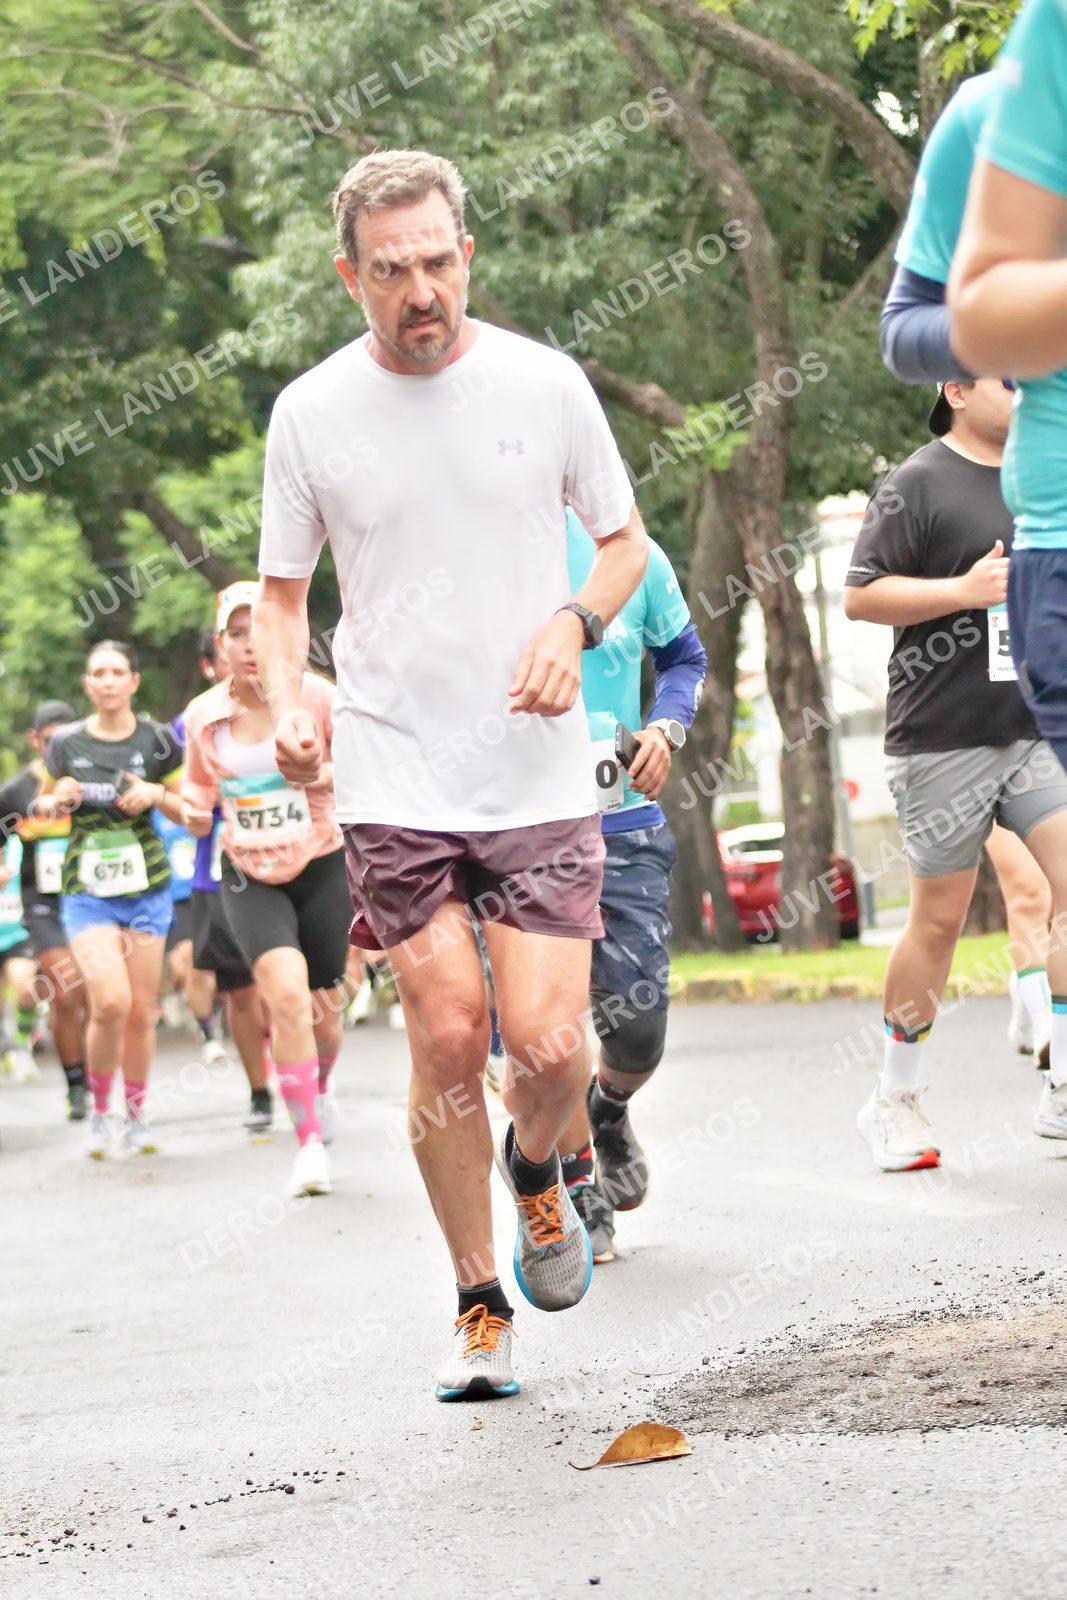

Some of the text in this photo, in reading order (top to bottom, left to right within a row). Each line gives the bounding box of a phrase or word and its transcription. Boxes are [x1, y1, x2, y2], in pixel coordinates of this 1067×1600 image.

[595, 759, 619, 789] 0
[237, 802, 304, 830] 6734
[94, 860, 134, 880] 678
